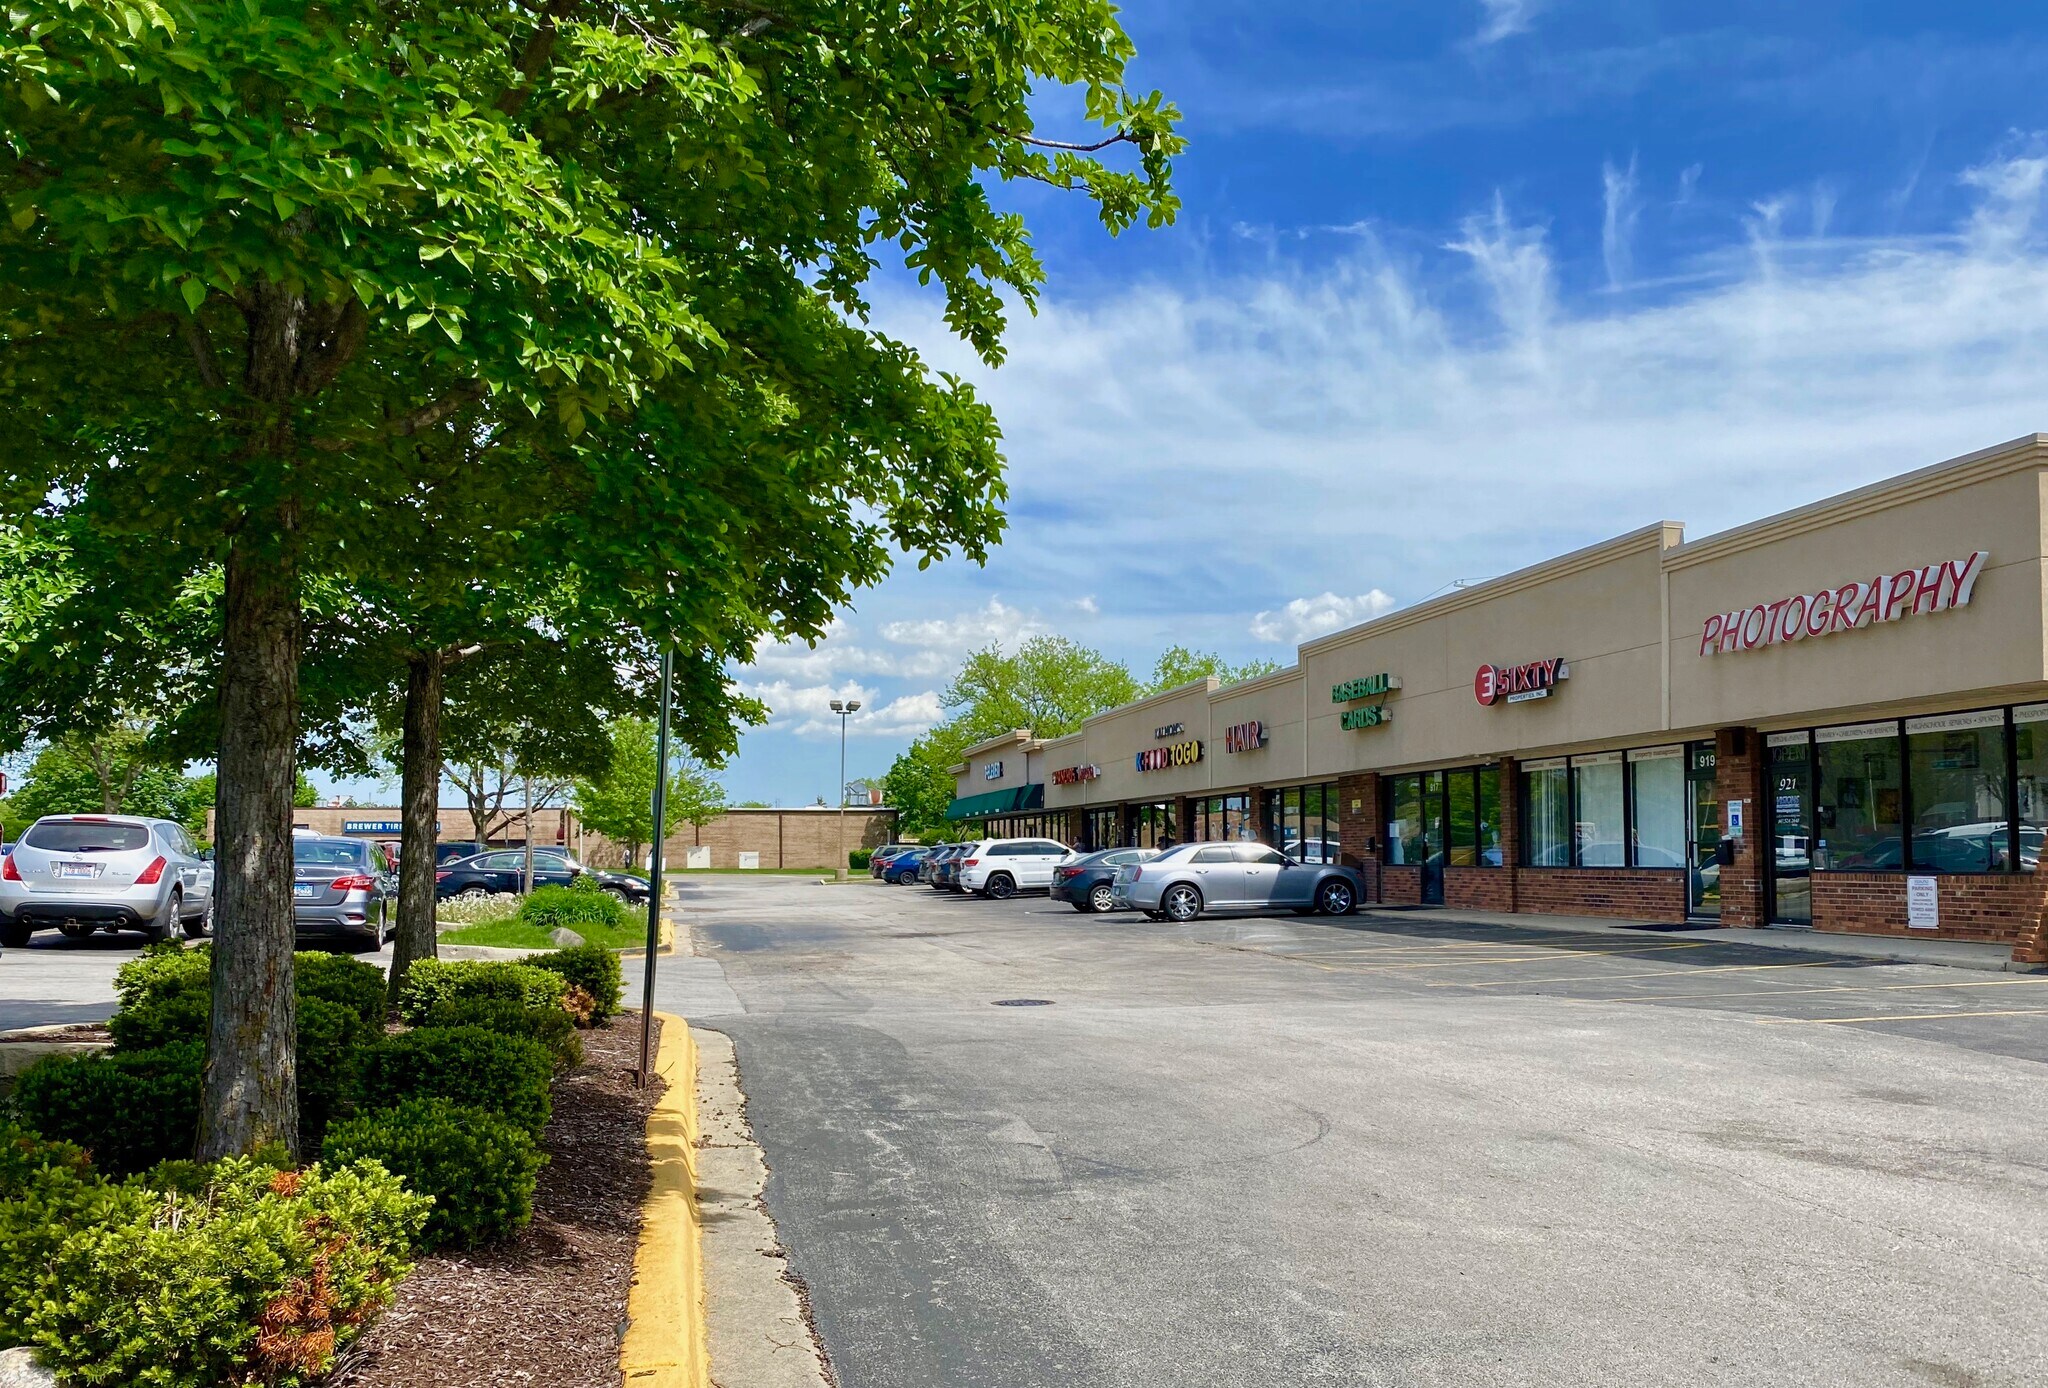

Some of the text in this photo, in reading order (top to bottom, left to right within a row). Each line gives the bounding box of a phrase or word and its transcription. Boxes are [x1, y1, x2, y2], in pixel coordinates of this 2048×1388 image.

[1698, 551, 1989, 657] PHOTOGRAPHY
[1331, 673, 1389, 704] BASEBALL
[1496, 658, 1562, 696] SIXTY
[1340, 705, 1382, 731] CARDS
[1978, 715, 2000, 725] SPORTS
[1225, 720, 1263, 754] HAIR
[1699, 754, 1716, 767] 919
[1778, 778, 1797, 791] 921
